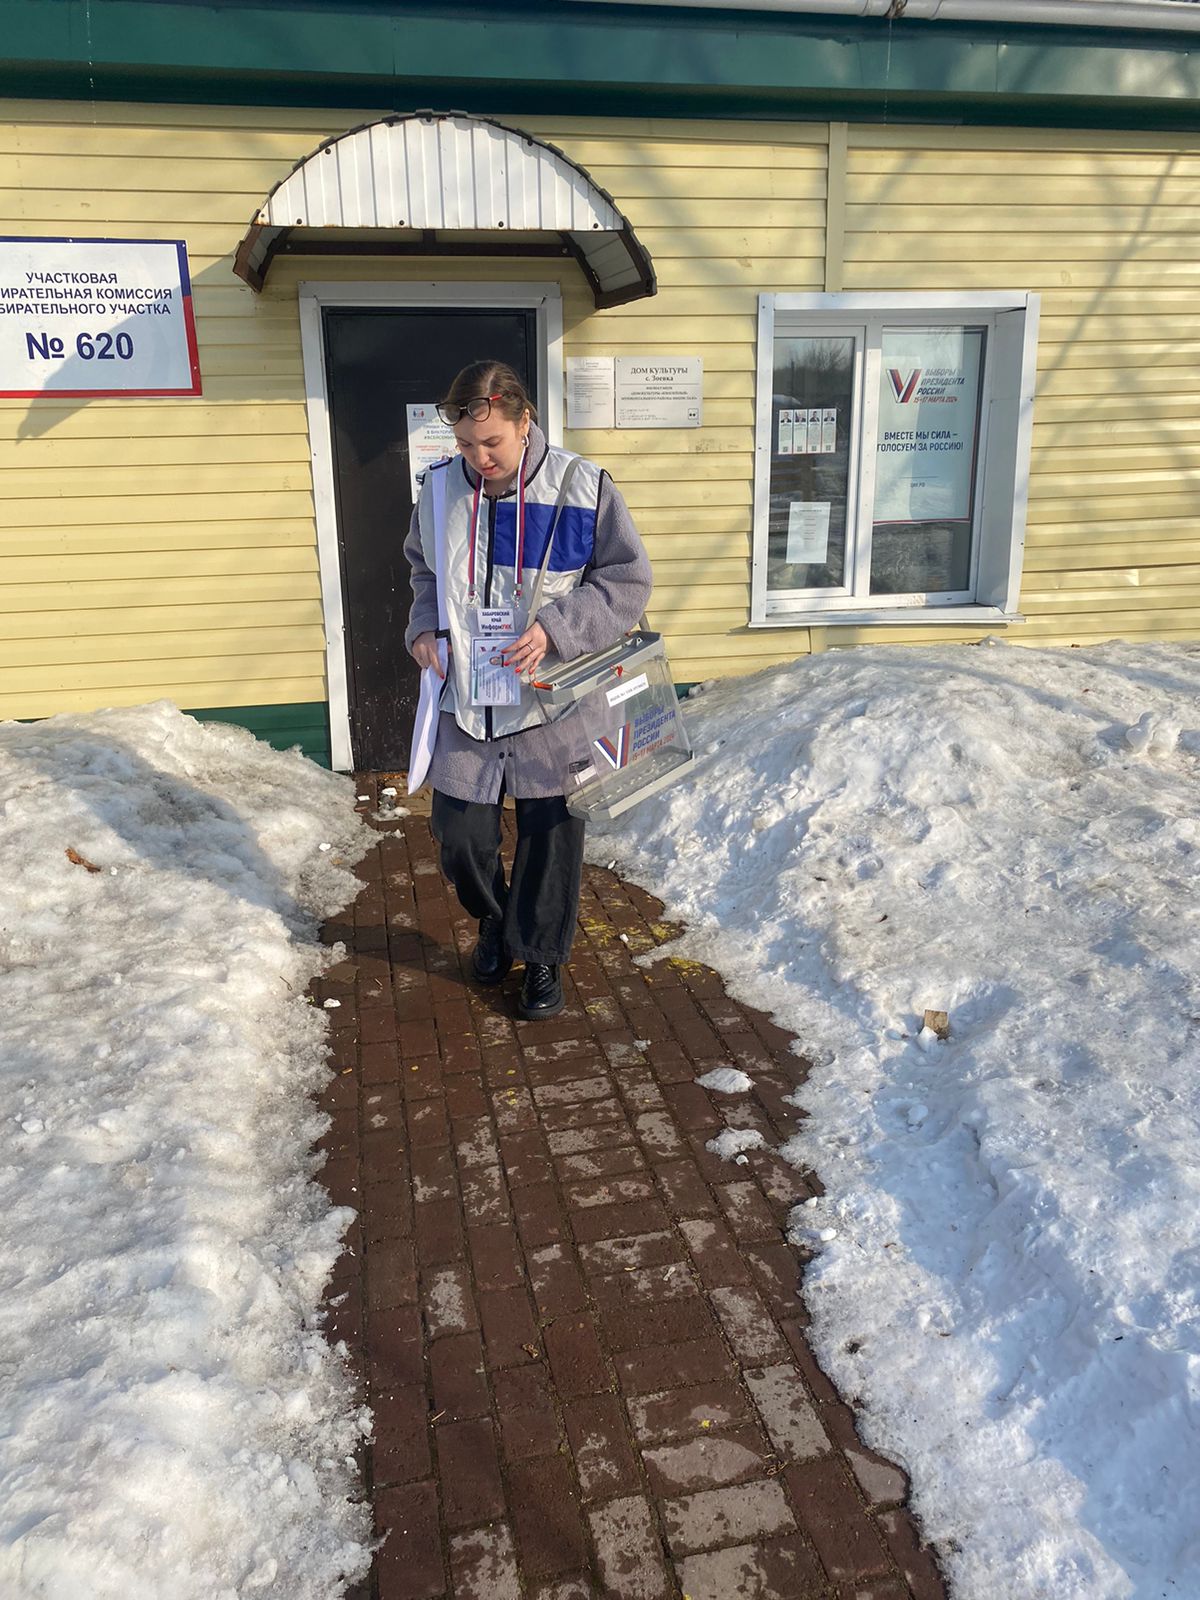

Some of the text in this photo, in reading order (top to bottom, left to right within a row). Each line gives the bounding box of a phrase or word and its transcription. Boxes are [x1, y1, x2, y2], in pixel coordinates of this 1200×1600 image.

[25, 272, 118, 284] УЧАСТКОВАЯ
[0, 288, 172, 300] ИРАТЕЛЬНАЯ КОМИССИЯ
[109, 303, 171, 315] УЧАСТКА
[25, 332, 135, 360] № 620
[631, 367, 688, 375] ДОМ КУЛЬТУРЫ
[920, 377, 965, 386] ПРЕЗИДЕНТА
[917, 387, 946, 395] РОССИИ
[884, 431, 914, 440] ВМЕСТЕ
[915, 431, 929, 440] МЫ
[931, 430, 951, 439] СИЛА
[876, 441, 964, 452] ГОЛОСУЕМ ЗА РОССИЮ!
[634, 704, 664, 728] ВЫБОРЫ
[633, 709, 676, 740] ПРЕЗИДЕНТА
[632, 729, 660, 752] РОССИИ
